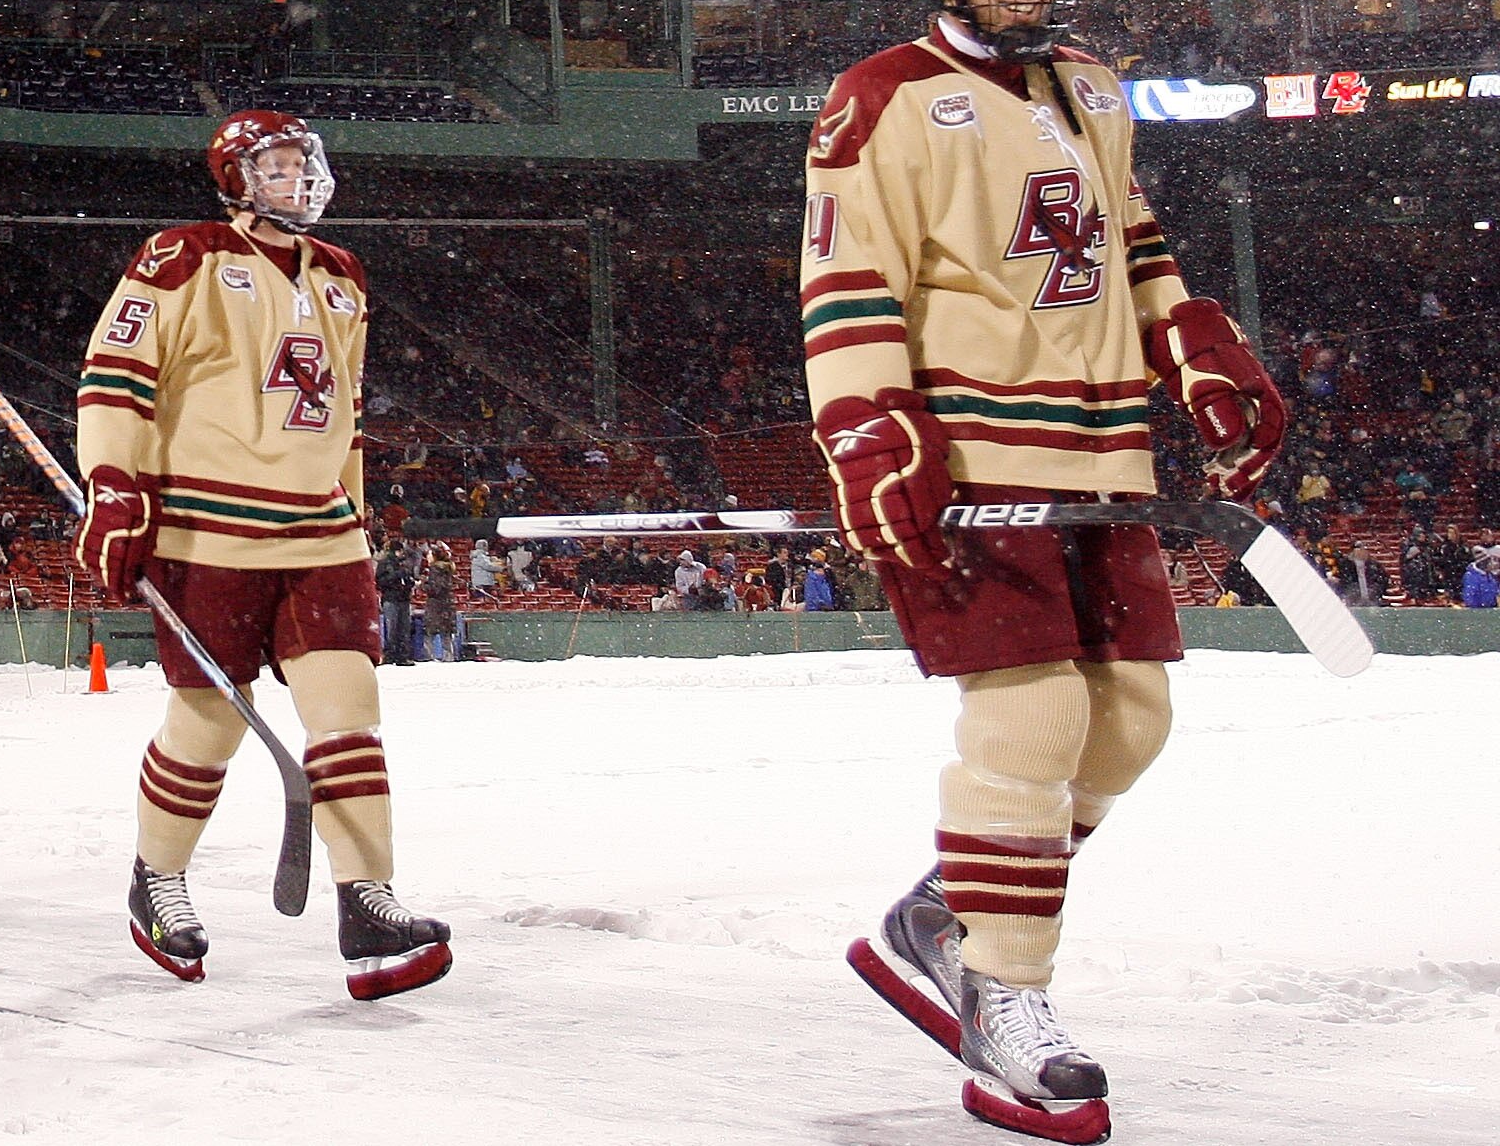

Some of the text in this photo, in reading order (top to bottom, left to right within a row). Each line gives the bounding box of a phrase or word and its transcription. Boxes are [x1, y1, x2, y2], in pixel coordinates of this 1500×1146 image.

[1194, 93, 1251, 103] HOCKEY
[1387, 81, 1425, 100] Sun
[1426, 77, 1465, 98] Life
[721, 96, 780, 113] EMC
[101, 294, 156, 349] 5
